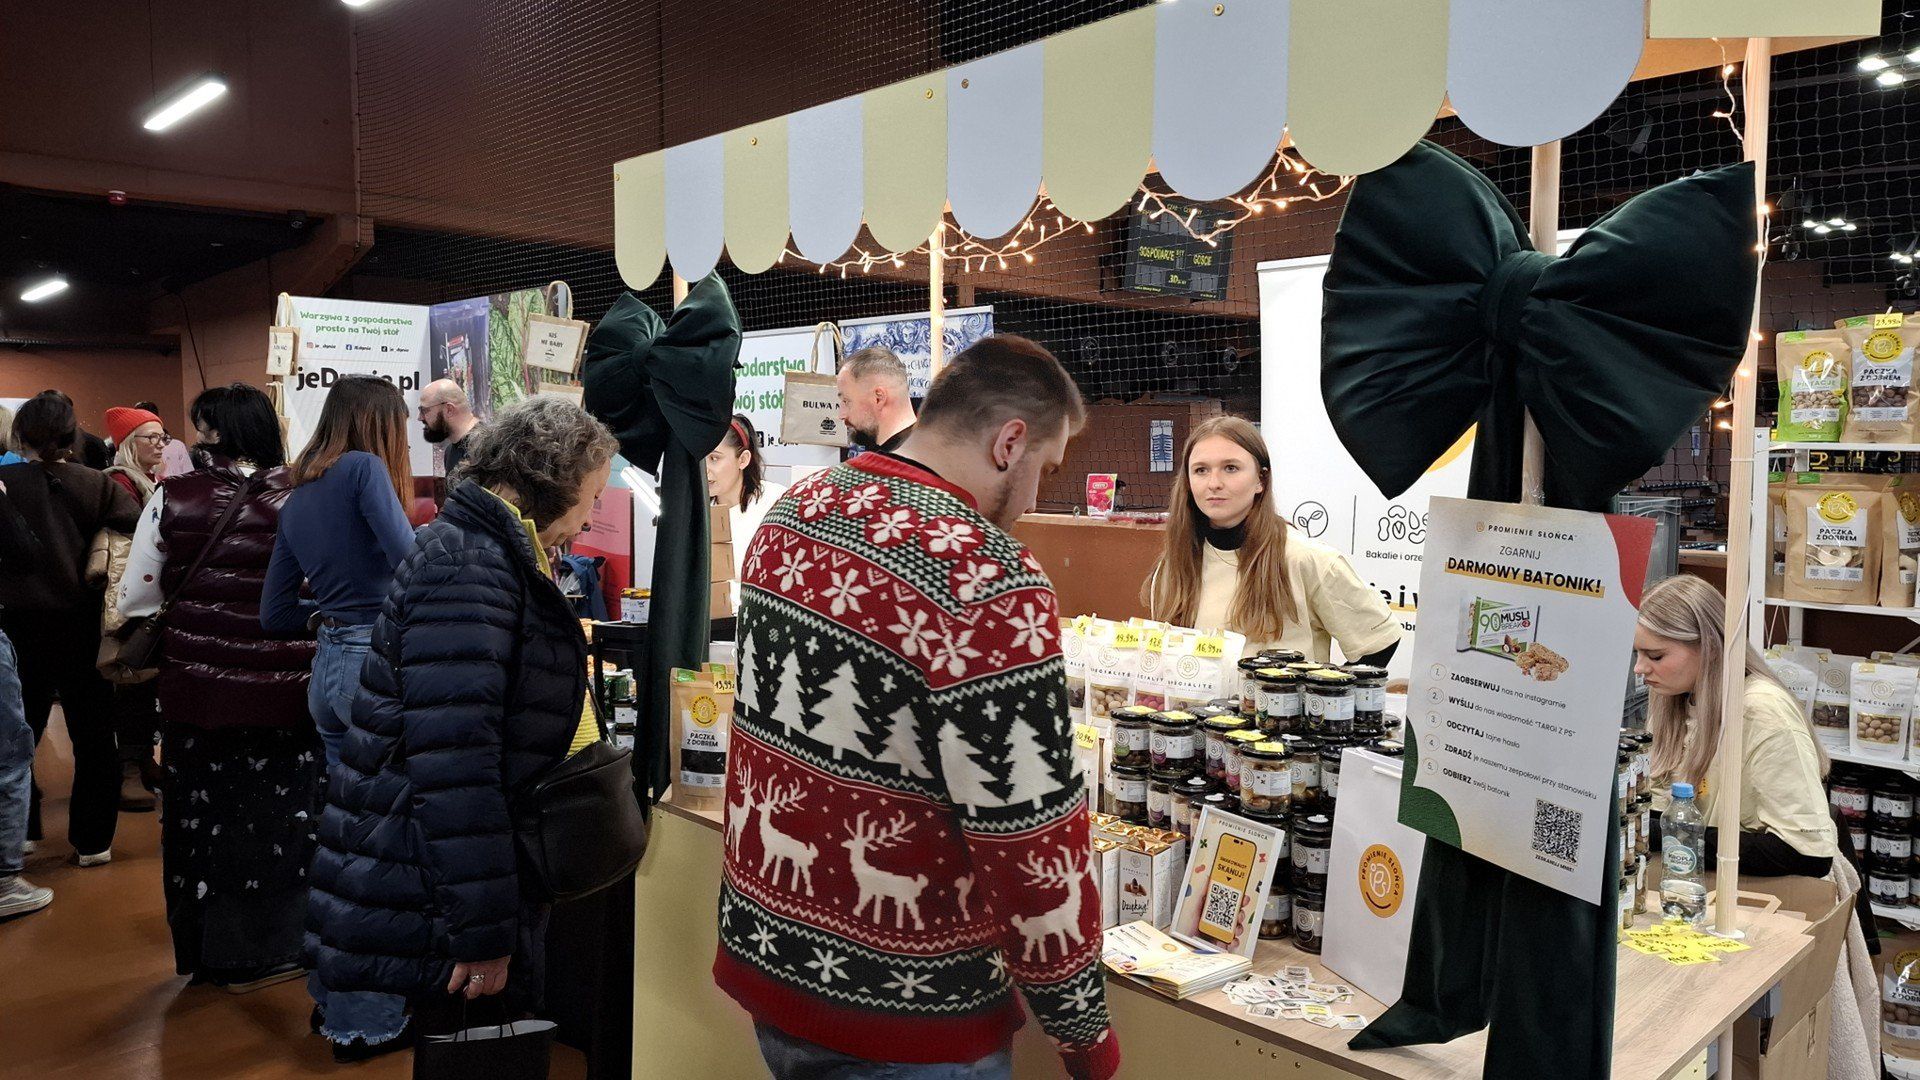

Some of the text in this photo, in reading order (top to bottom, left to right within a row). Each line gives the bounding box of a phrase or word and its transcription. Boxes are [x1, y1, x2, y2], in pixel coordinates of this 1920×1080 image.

[300, 311, 342, 321] Warzywa
[352, 315, 413, 326] gospodarstwa
[315, 325, 345, 333] prosto
[802, 400, 833, 410] BULWA
[1488, 524, 1575, 541] PROMIENIE SŁOŃCA
[1365, 550, 1398, 561] Bakalie
[1499, 545, 1541, 560] ZGARNIJ
[1447, 557, 1601, 593] DARMOWY BATONIK!
[1480, 610, 1530, 633] 90 MUSLI
[1450, 673, 1500, 692] ZAOBSERWUJ
[1501, 687, 1513, 695] nas
[1448, 696, 1474, 709] WYŚLIJ
[1558, 726, 1563, 734] Z
[690, 732, 716, 741] PACZKA
[1446, 720, 1485, 738] ODCZYTAJ
[692, 739, 719, 747] DOBREM
[1444, 743, 1472, 759] ZDRADŹ
[1480, 757, 1508, 771] naszemu
[1542, 776, 1557, 788] przy
[1557, 782, 1597, 800] stanowisku
[1443, 768, 1472, 784] ODBIERZ
[1487, 784, 1511, 797] batonik
[1361, 850, 1401, 896] PROMIENIE SŁOŃCA
